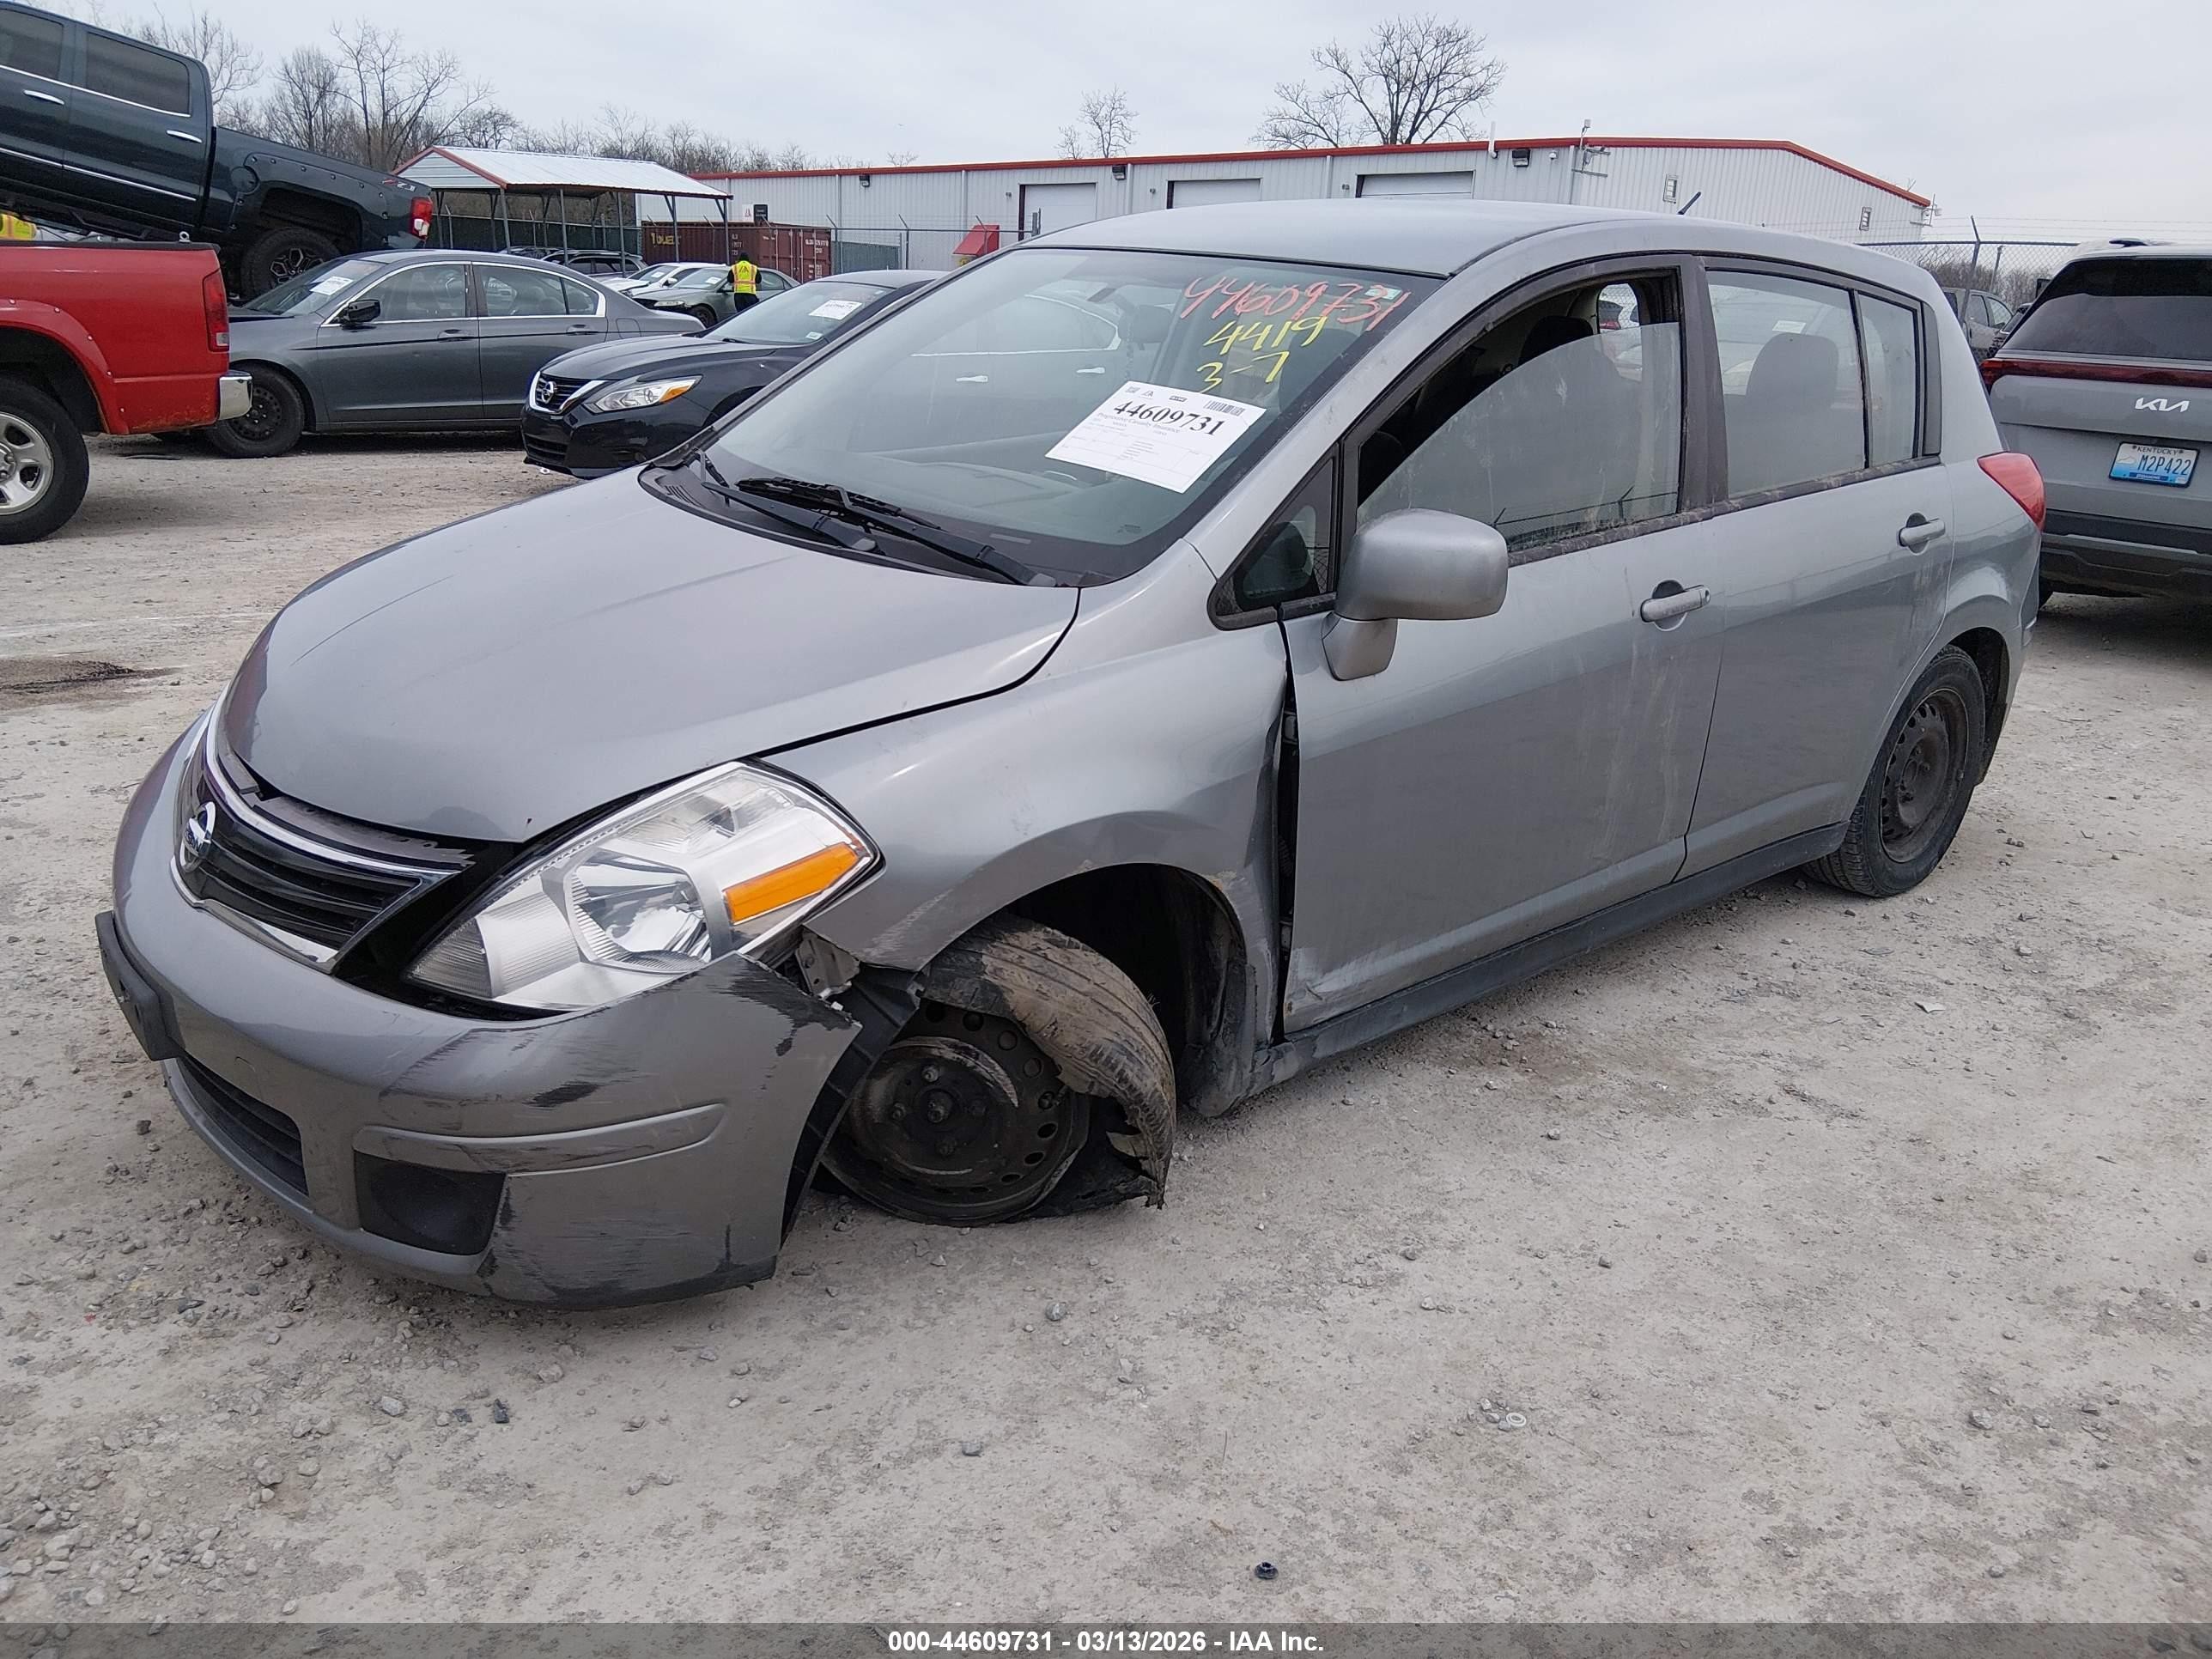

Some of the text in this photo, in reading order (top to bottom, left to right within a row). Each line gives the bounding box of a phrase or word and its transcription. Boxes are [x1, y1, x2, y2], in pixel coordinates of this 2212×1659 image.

[1181, 276, 1412, 331] 44609731
[1203, 316, 1328, 355] 4419
[1114, 400, 1225, 436] 44609731
[2135, 398, 2190, 412] KIA
[2137, 447, 2179, 455] KENTUCKY
[2137, 454, 2191, 476] M2P422
